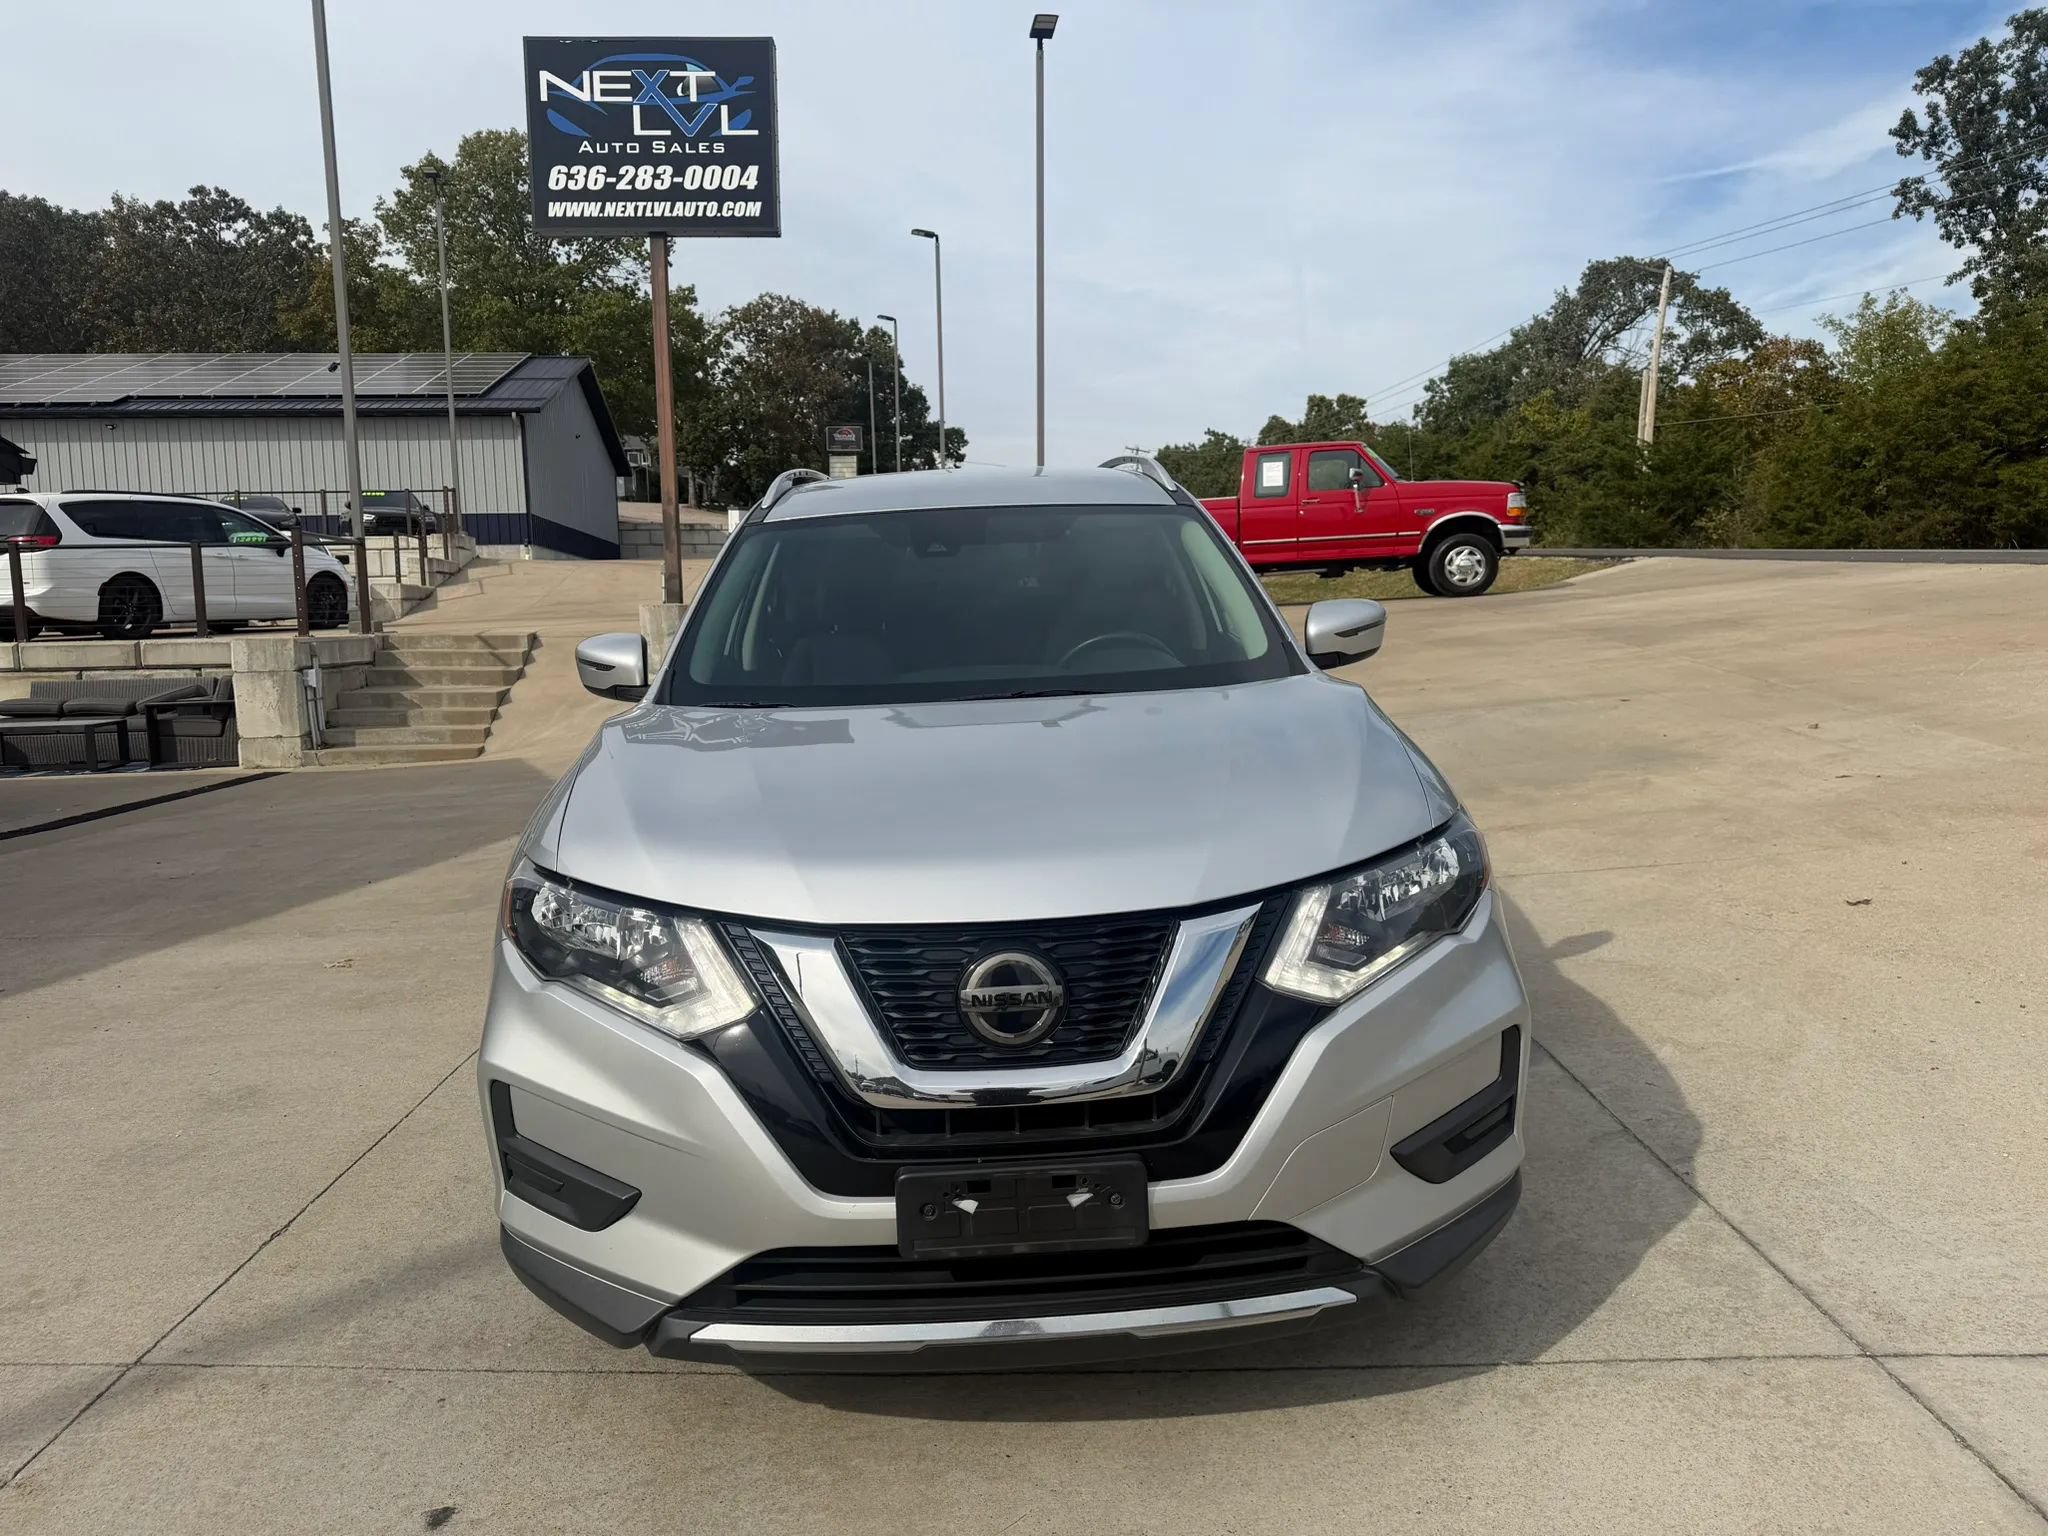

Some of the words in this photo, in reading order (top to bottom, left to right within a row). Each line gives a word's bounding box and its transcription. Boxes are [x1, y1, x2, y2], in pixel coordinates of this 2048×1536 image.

[539, 69, 716, 103] NEXT
[633, 103, 759, 137] LVL
[578, 140, 640, 154] AUTO
[652, 140, 725, 154] SALES
[548, 164, 760, 191] 636-283-0004
[548, 201, 762, 218] WWW.NEXTLVLAUTO.COM
[971, 990, 1053, 1008] NISSAN
